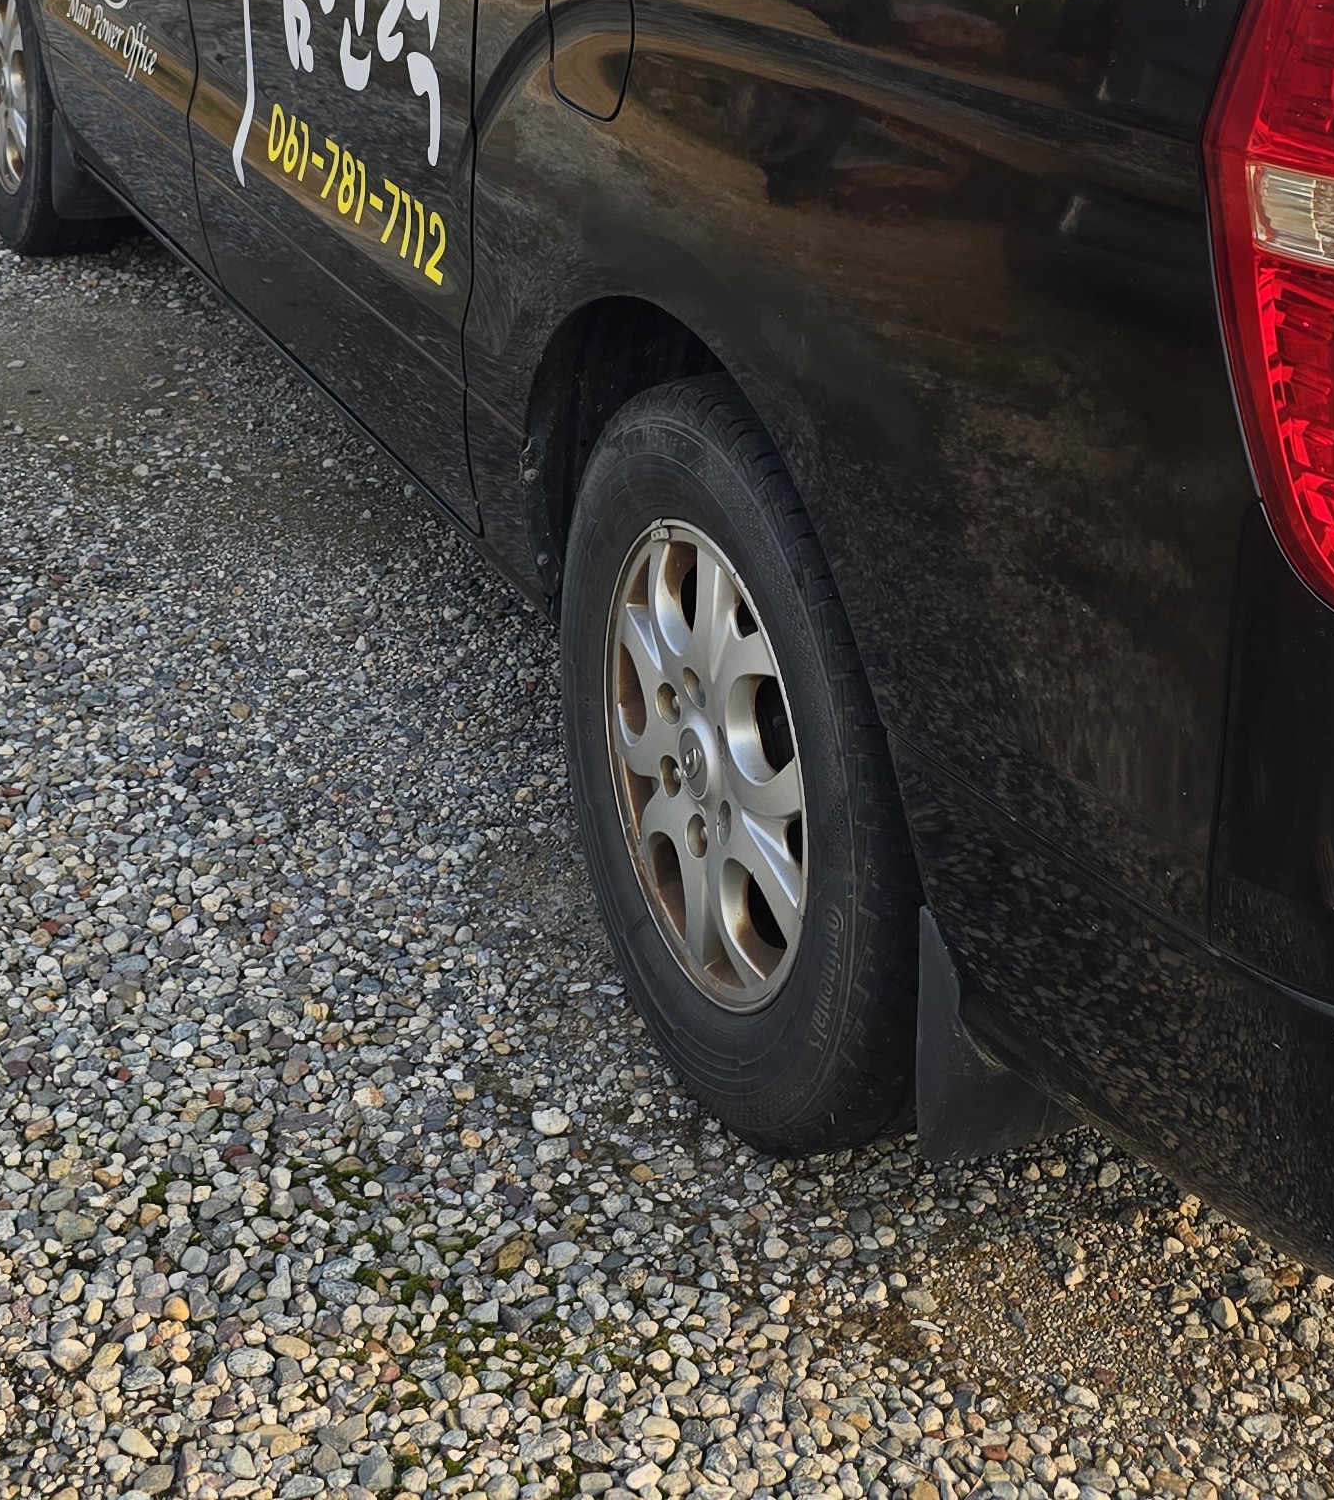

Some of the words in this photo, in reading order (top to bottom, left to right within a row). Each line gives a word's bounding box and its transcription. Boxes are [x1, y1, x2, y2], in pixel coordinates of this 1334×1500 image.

[91, 4, 125, 51] Power
[122, 21, 158, 82] Office
[267, 103, 446, 286] 061-781-7112
